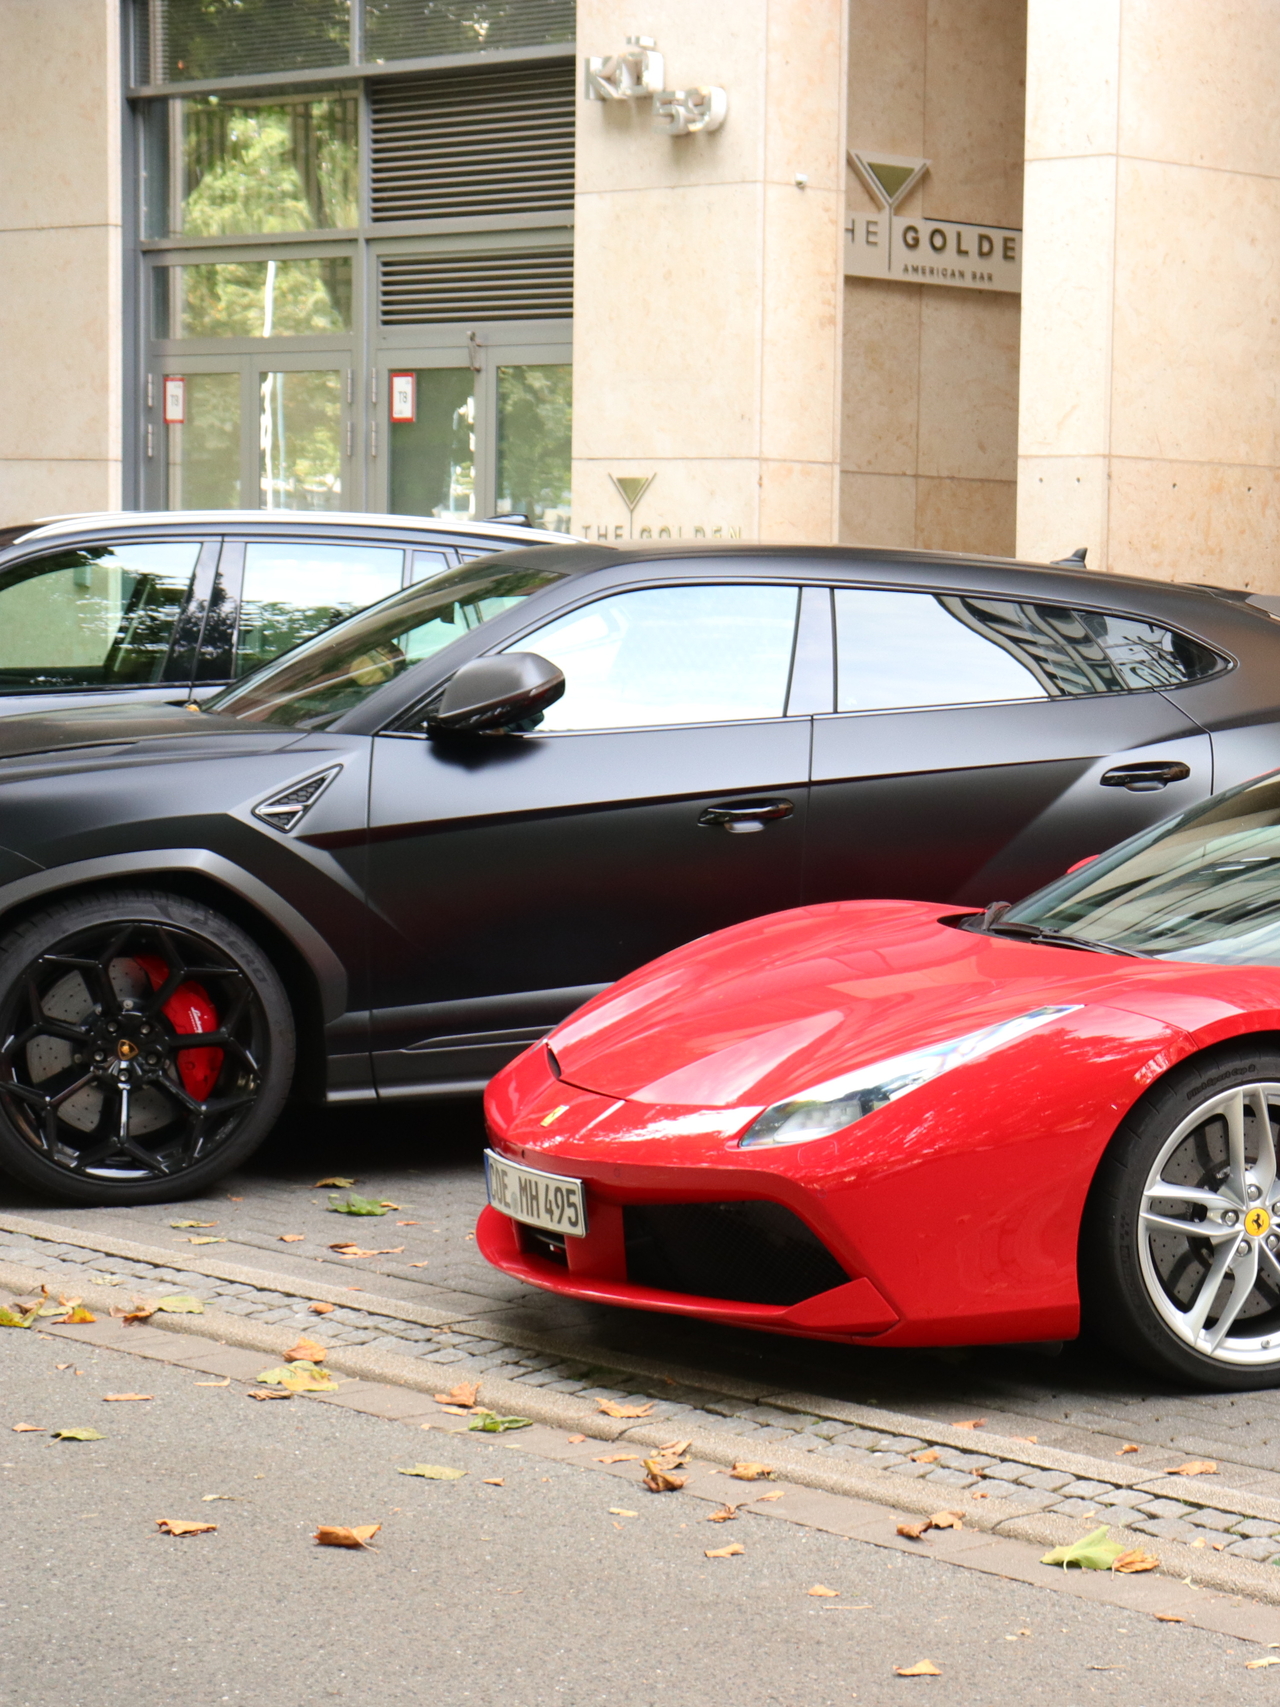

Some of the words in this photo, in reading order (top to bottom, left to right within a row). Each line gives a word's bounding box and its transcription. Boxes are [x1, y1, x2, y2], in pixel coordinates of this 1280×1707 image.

[652, 85, 728, 135] 59
[902, 224, 1016, 261] GOLDE
[903, 264, 965, 280] AMERICAN
[970, 270, 993, 283] BAR
[582, 525, 624, 541] THE
[518, 1175, 541, 1220] MH
[544, 1183, 579, 1228] 495
